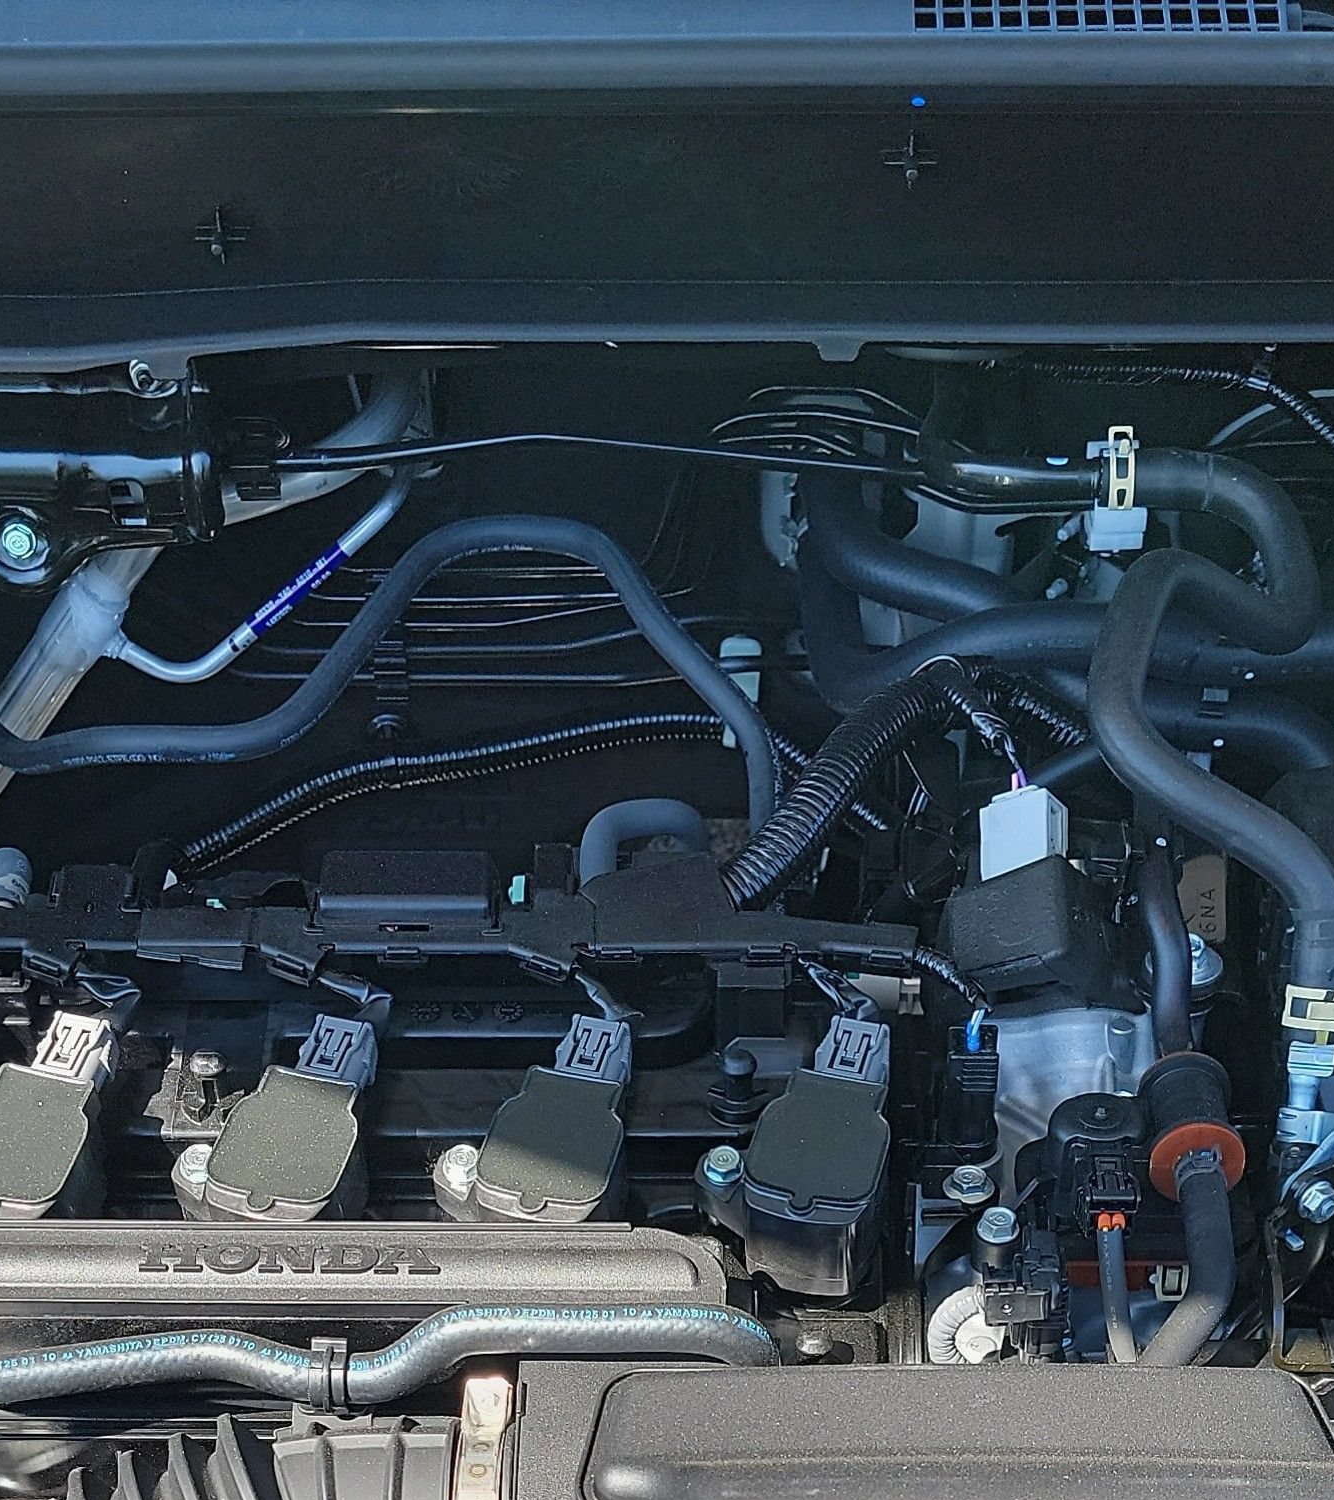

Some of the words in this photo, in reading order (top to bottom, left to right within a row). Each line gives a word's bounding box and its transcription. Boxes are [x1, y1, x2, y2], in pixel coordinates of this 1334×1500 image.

[138, 1242, 442, 1275] HONDA
[441, 1307, 512, 1325] YAMASHITA
[562, 1307, 578, 1319] CV
[622, 1307, 637, 1318] 10
[655, 1307, 729, 1322] YAMASHITA
[41, 1352, 58, 1363] 10
[76, 1340, 144, 1358] YAMASHITA
[191, 1333, 208, 1345] CV
[273, 1349, 311, 1369] YAMAS
